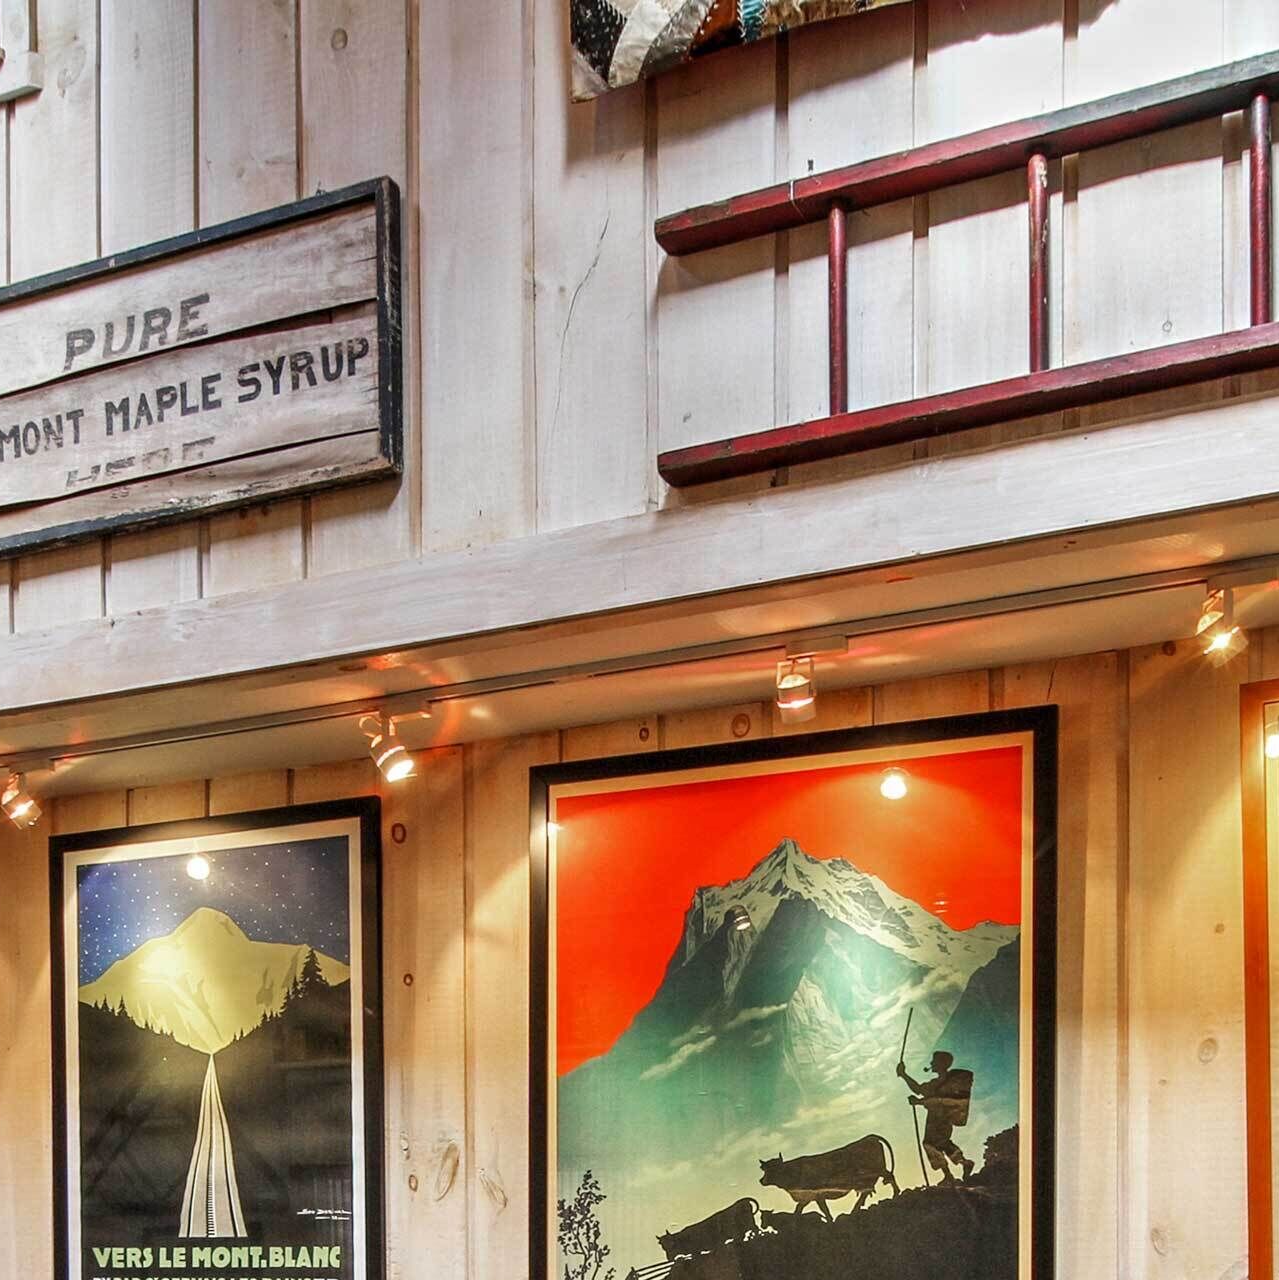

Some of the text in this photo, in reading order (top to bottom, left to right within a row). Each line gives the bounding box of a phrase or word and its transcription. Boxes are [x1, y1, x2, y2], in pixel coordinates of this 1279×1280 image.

[62, 292, 211, 372] PURE
[104, 372, 223, 436] MAPLE
[237, 336, 370, 404] SYRUP
[91, 1246, 154, 1269] VERS
[158, 1246, 187, 1269] LE
